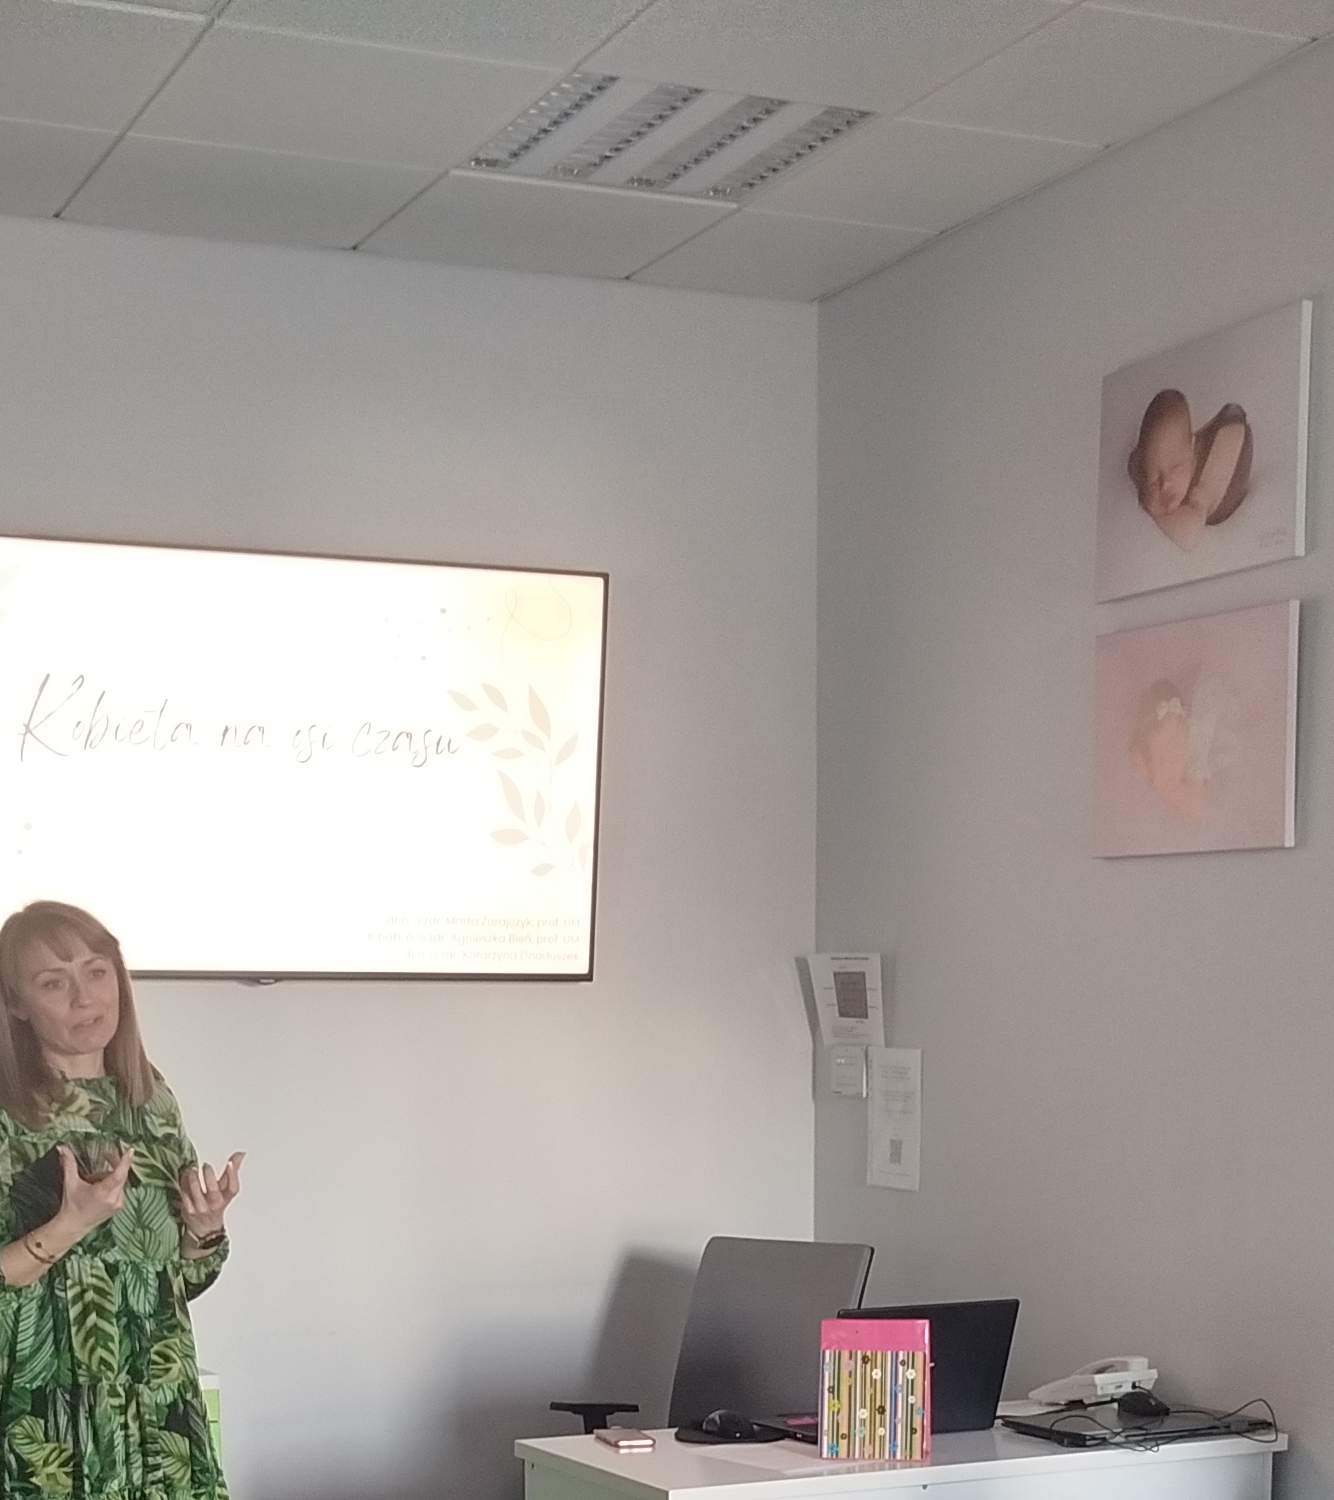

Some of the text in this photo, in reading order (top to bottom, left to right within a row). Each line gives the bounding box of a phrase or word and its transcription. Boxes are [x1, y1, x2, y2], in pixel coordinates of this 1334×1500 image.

[17, 673, 199, 762] Kobieta
[220, 721, 272, 750] na
[446, 916, 479, 927] Marta
[451, 932, 506, 948] Agnieszka
